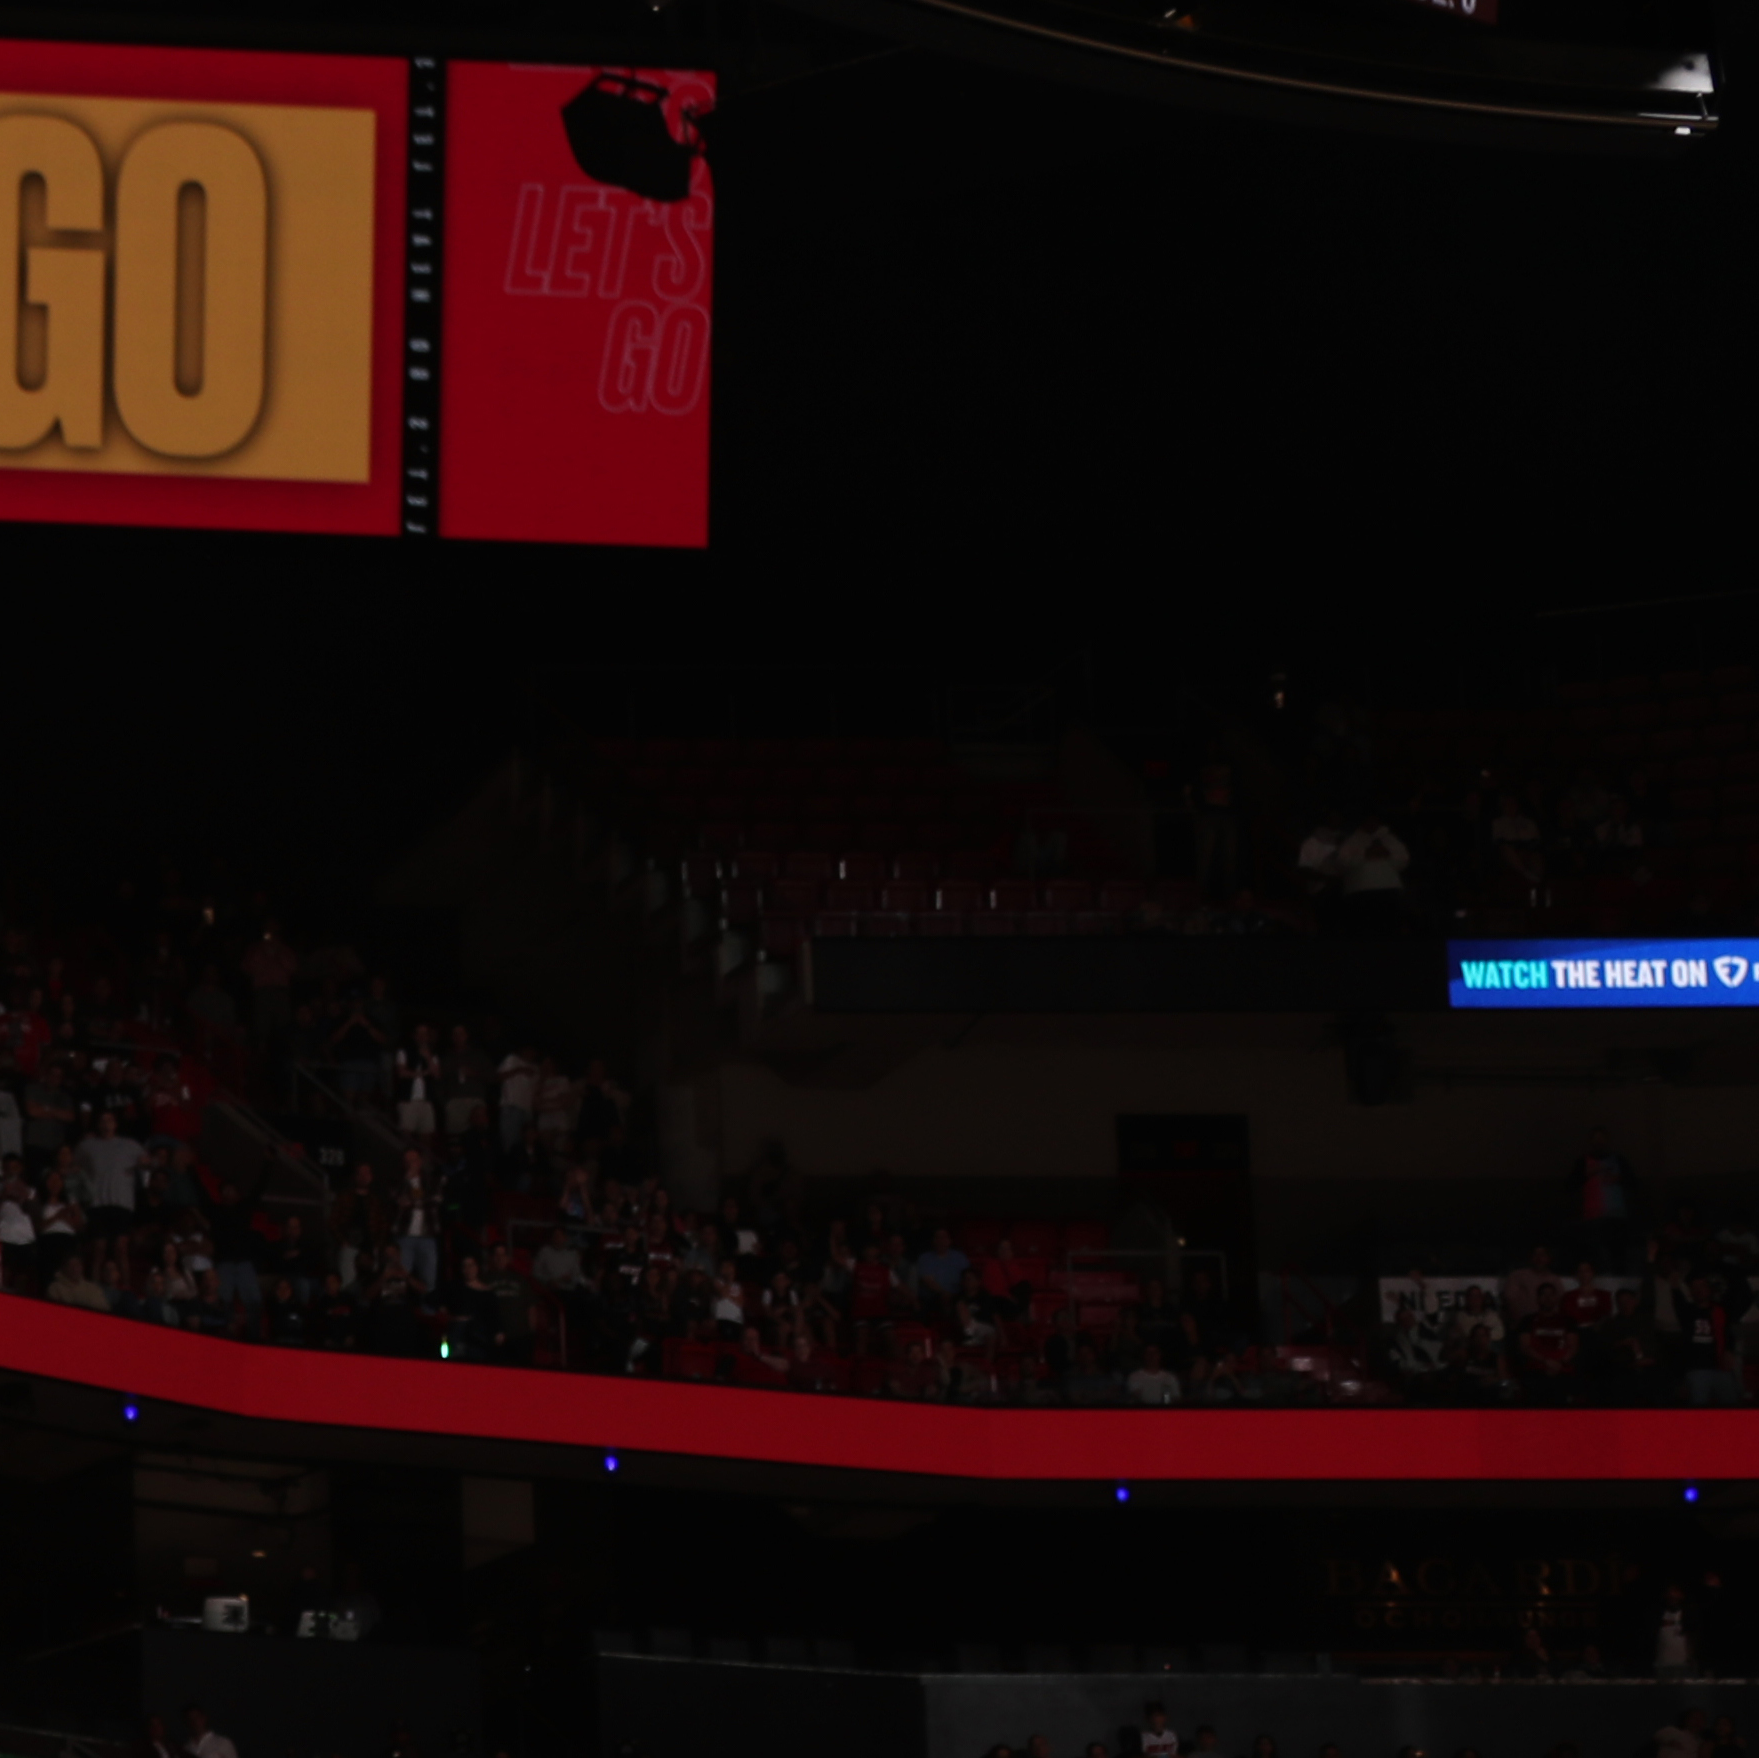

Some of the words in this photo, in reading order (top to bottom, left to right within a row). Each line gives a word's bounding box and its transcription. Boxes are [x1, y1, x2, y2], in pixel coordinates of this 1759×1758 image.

[597, 300, 709, 413] GO
[1460, 960, 1549, 989] WATCH
[1551, 960, 1600, 989] THE
[1604, 960, 1667, 989] HEAT
[1670, 960, 1709, 988] ON
